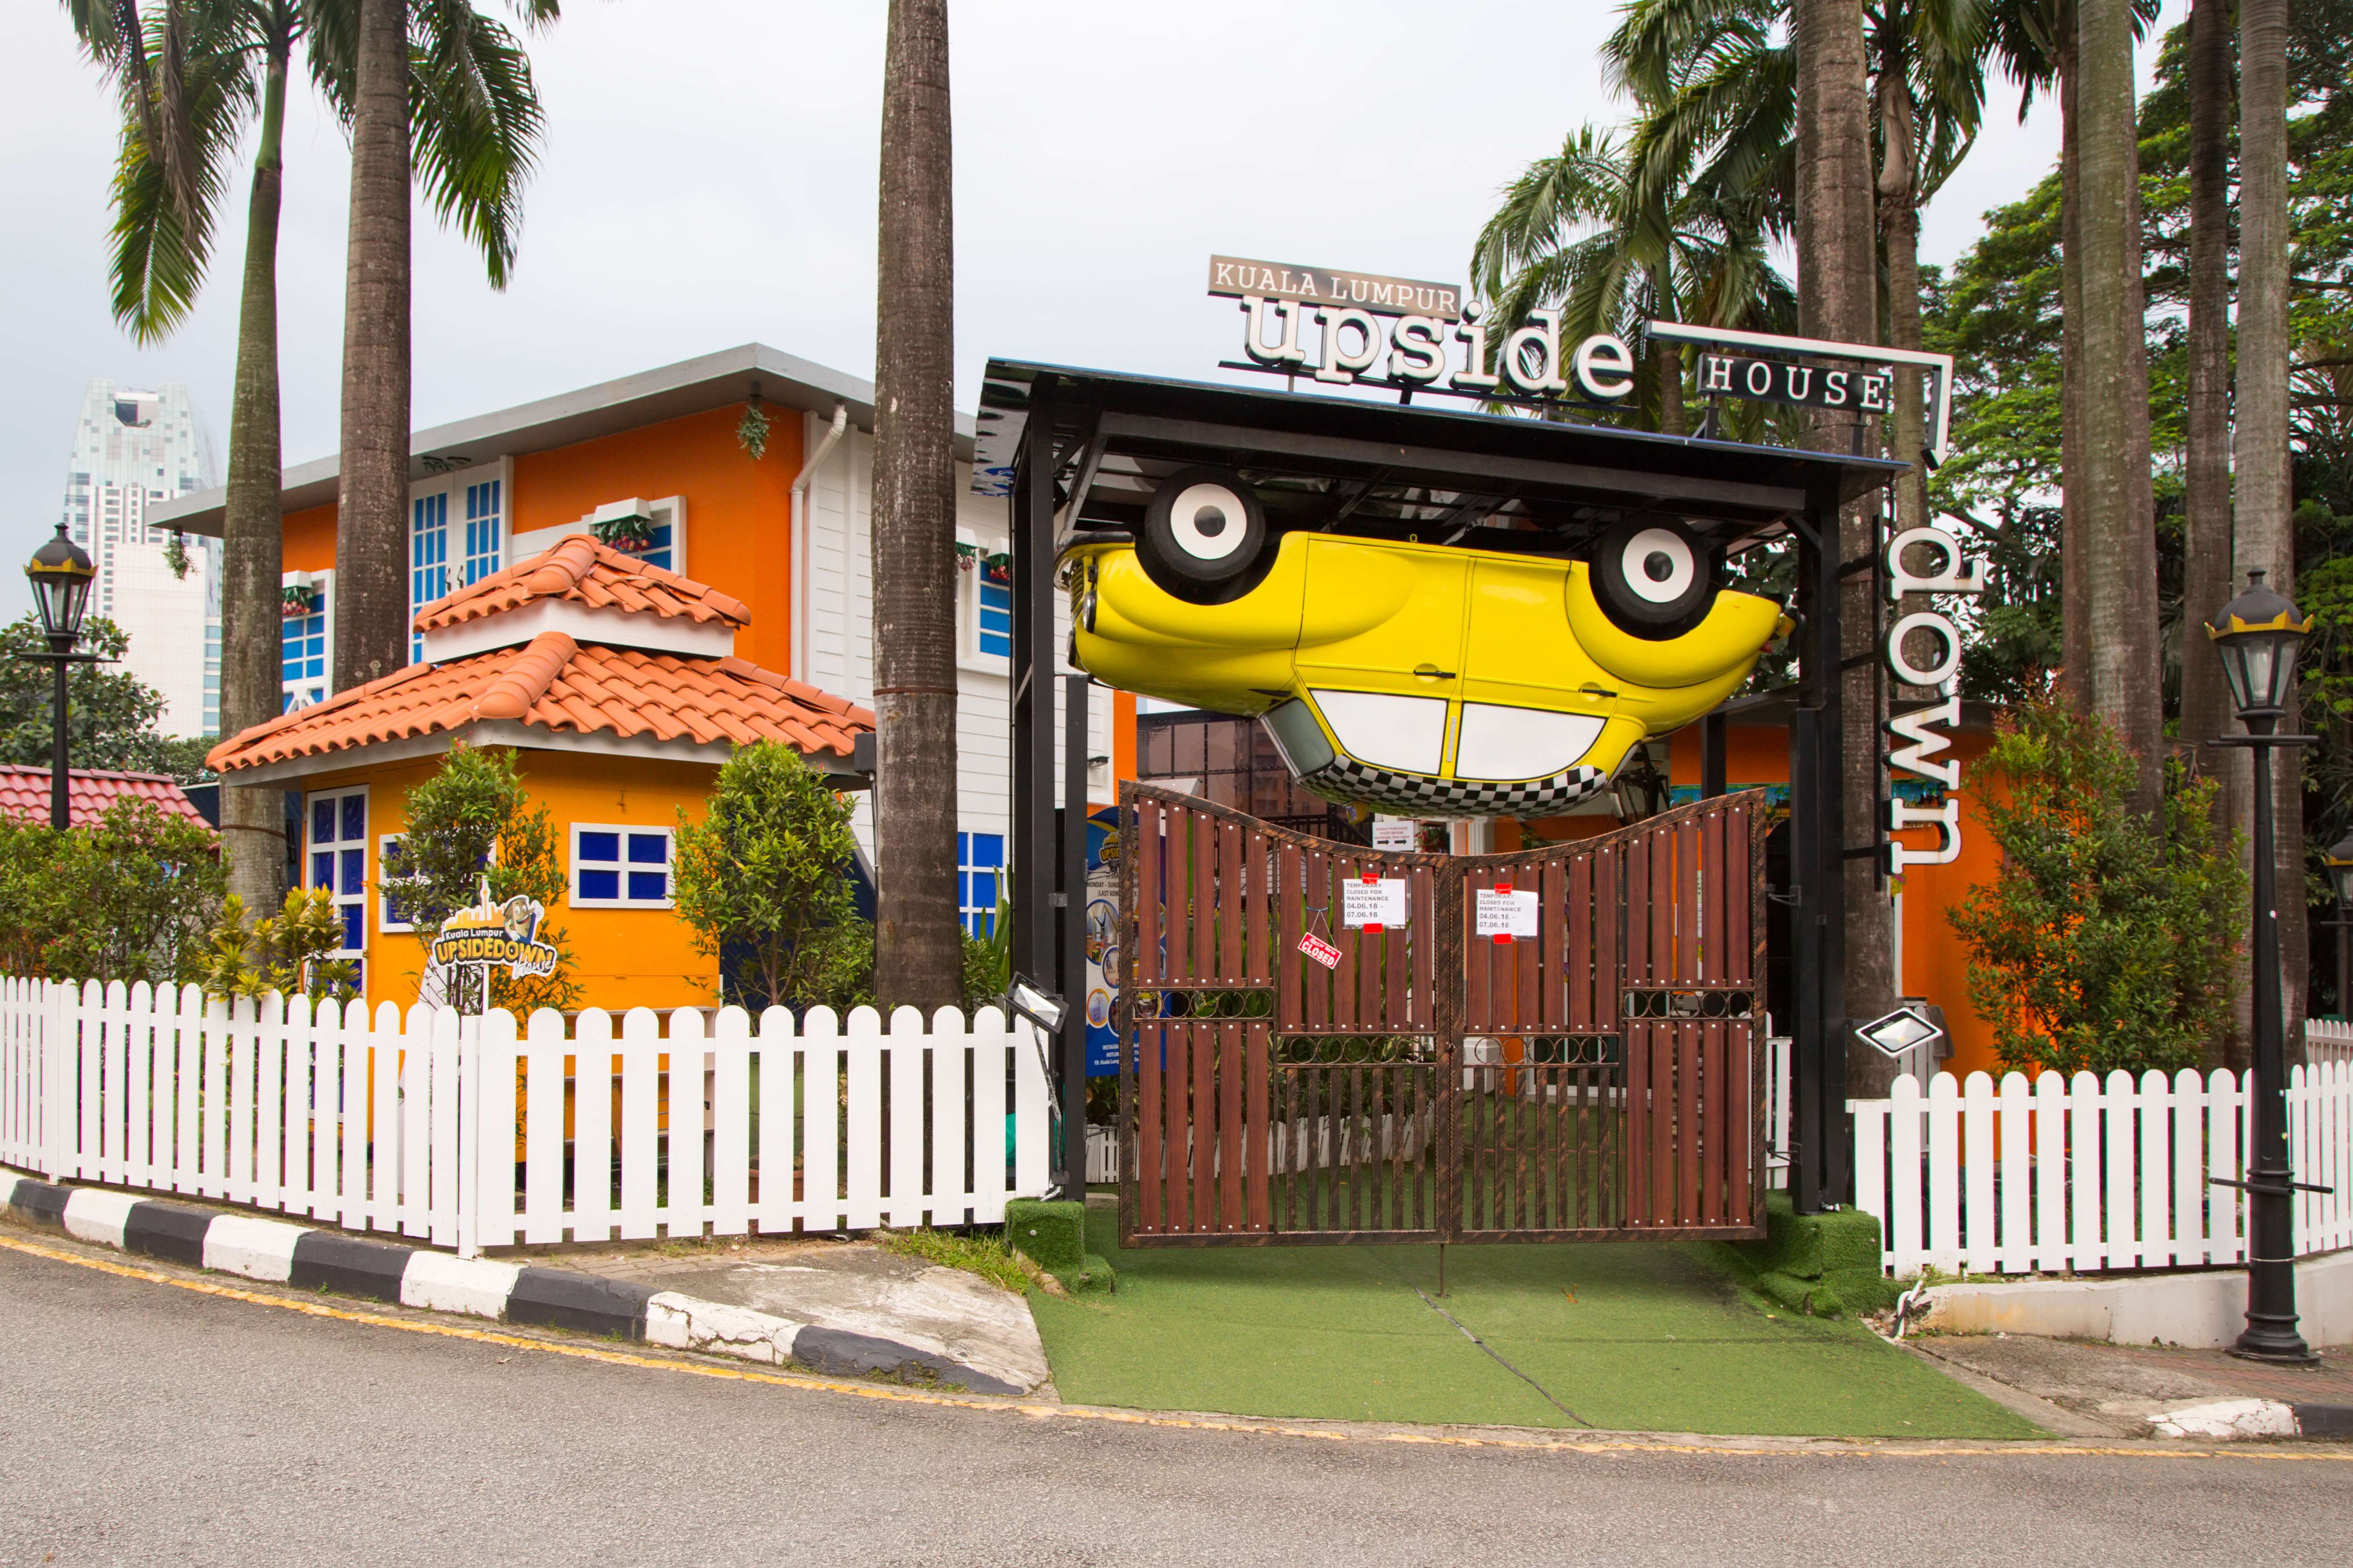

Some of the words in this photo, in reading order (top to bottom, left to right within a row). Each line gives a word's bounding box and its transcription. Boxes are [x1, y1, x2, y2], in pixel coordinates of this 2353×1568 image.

[1215, 263, 1318, 297] KUALA
[1330, 276, 1458, 314] LUMPUR
[1240, 295, 1634, 401] upside
[1706, 357, 1885, 409] HOUSE
[1883, 526, 1984, 875] down
[436, 938, 553, 963] UPSIDEDOWN
[445, 930, 469, 940] Kuala
[471, 928, 504, 938] Lumpur
[514, 952, 552, 977] House
[1302, 941, 1335, 966] CLOSED
